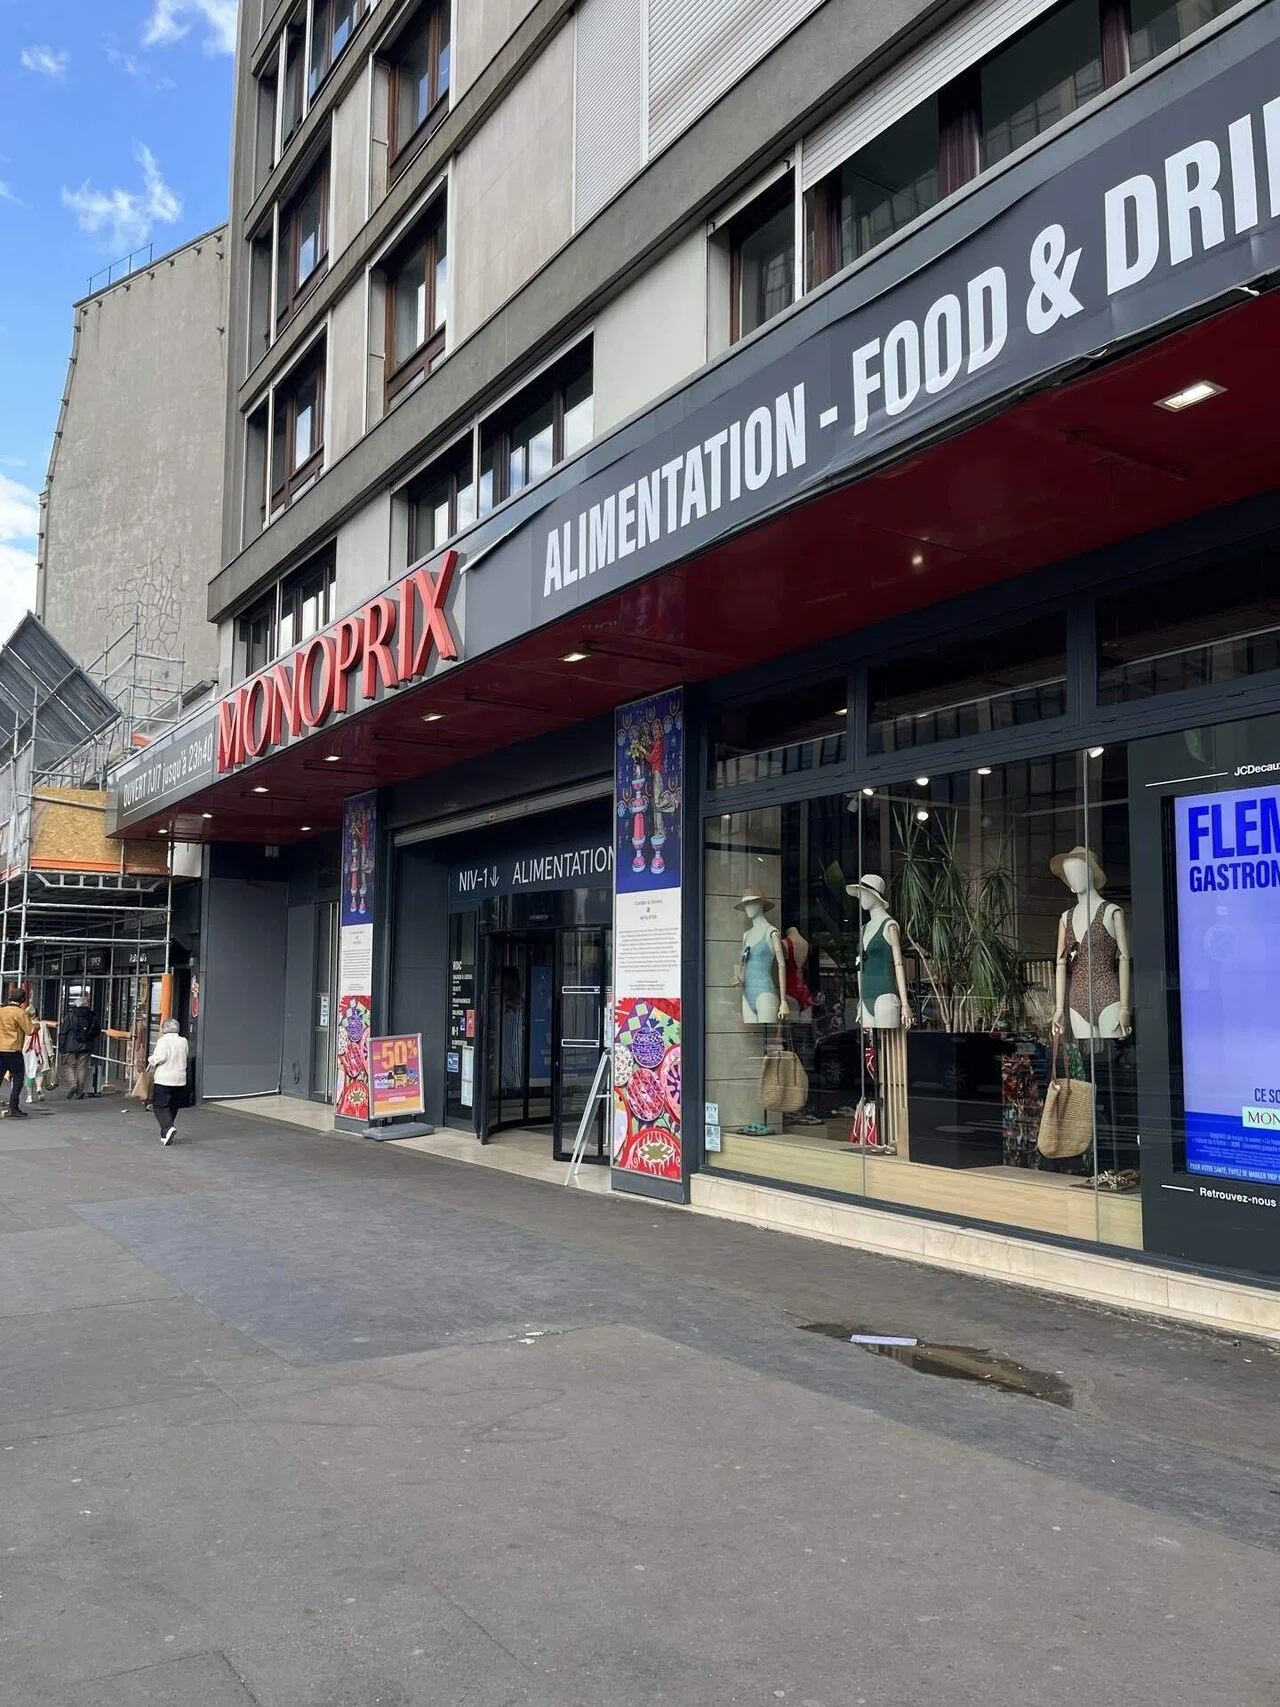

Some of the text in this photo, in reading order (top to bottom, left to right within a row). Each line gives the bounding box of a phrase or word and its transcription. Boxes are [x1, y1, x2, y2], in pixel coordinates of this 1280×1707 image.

[543, 382, 806, 598] ALIMENTATION
[852, 266, 1008, 437] FOOD
[1026, 223, 1084, 335] &
[217, 550, 459, 773] MONOPRIX
[123, 772, 148, 808] OUVERT
[188, 733, 213, 773] 23h40
[1234, 763, 1280, 776] JCDecau
[459, 845, 615, 892] NIV-1 ALIMENTATION
[373, 1039, 417, 1070] -50%
[1254, 1088, 1267, 1103] CE
[1200, 1187, 1277, 1207] Retrouvez-nous
